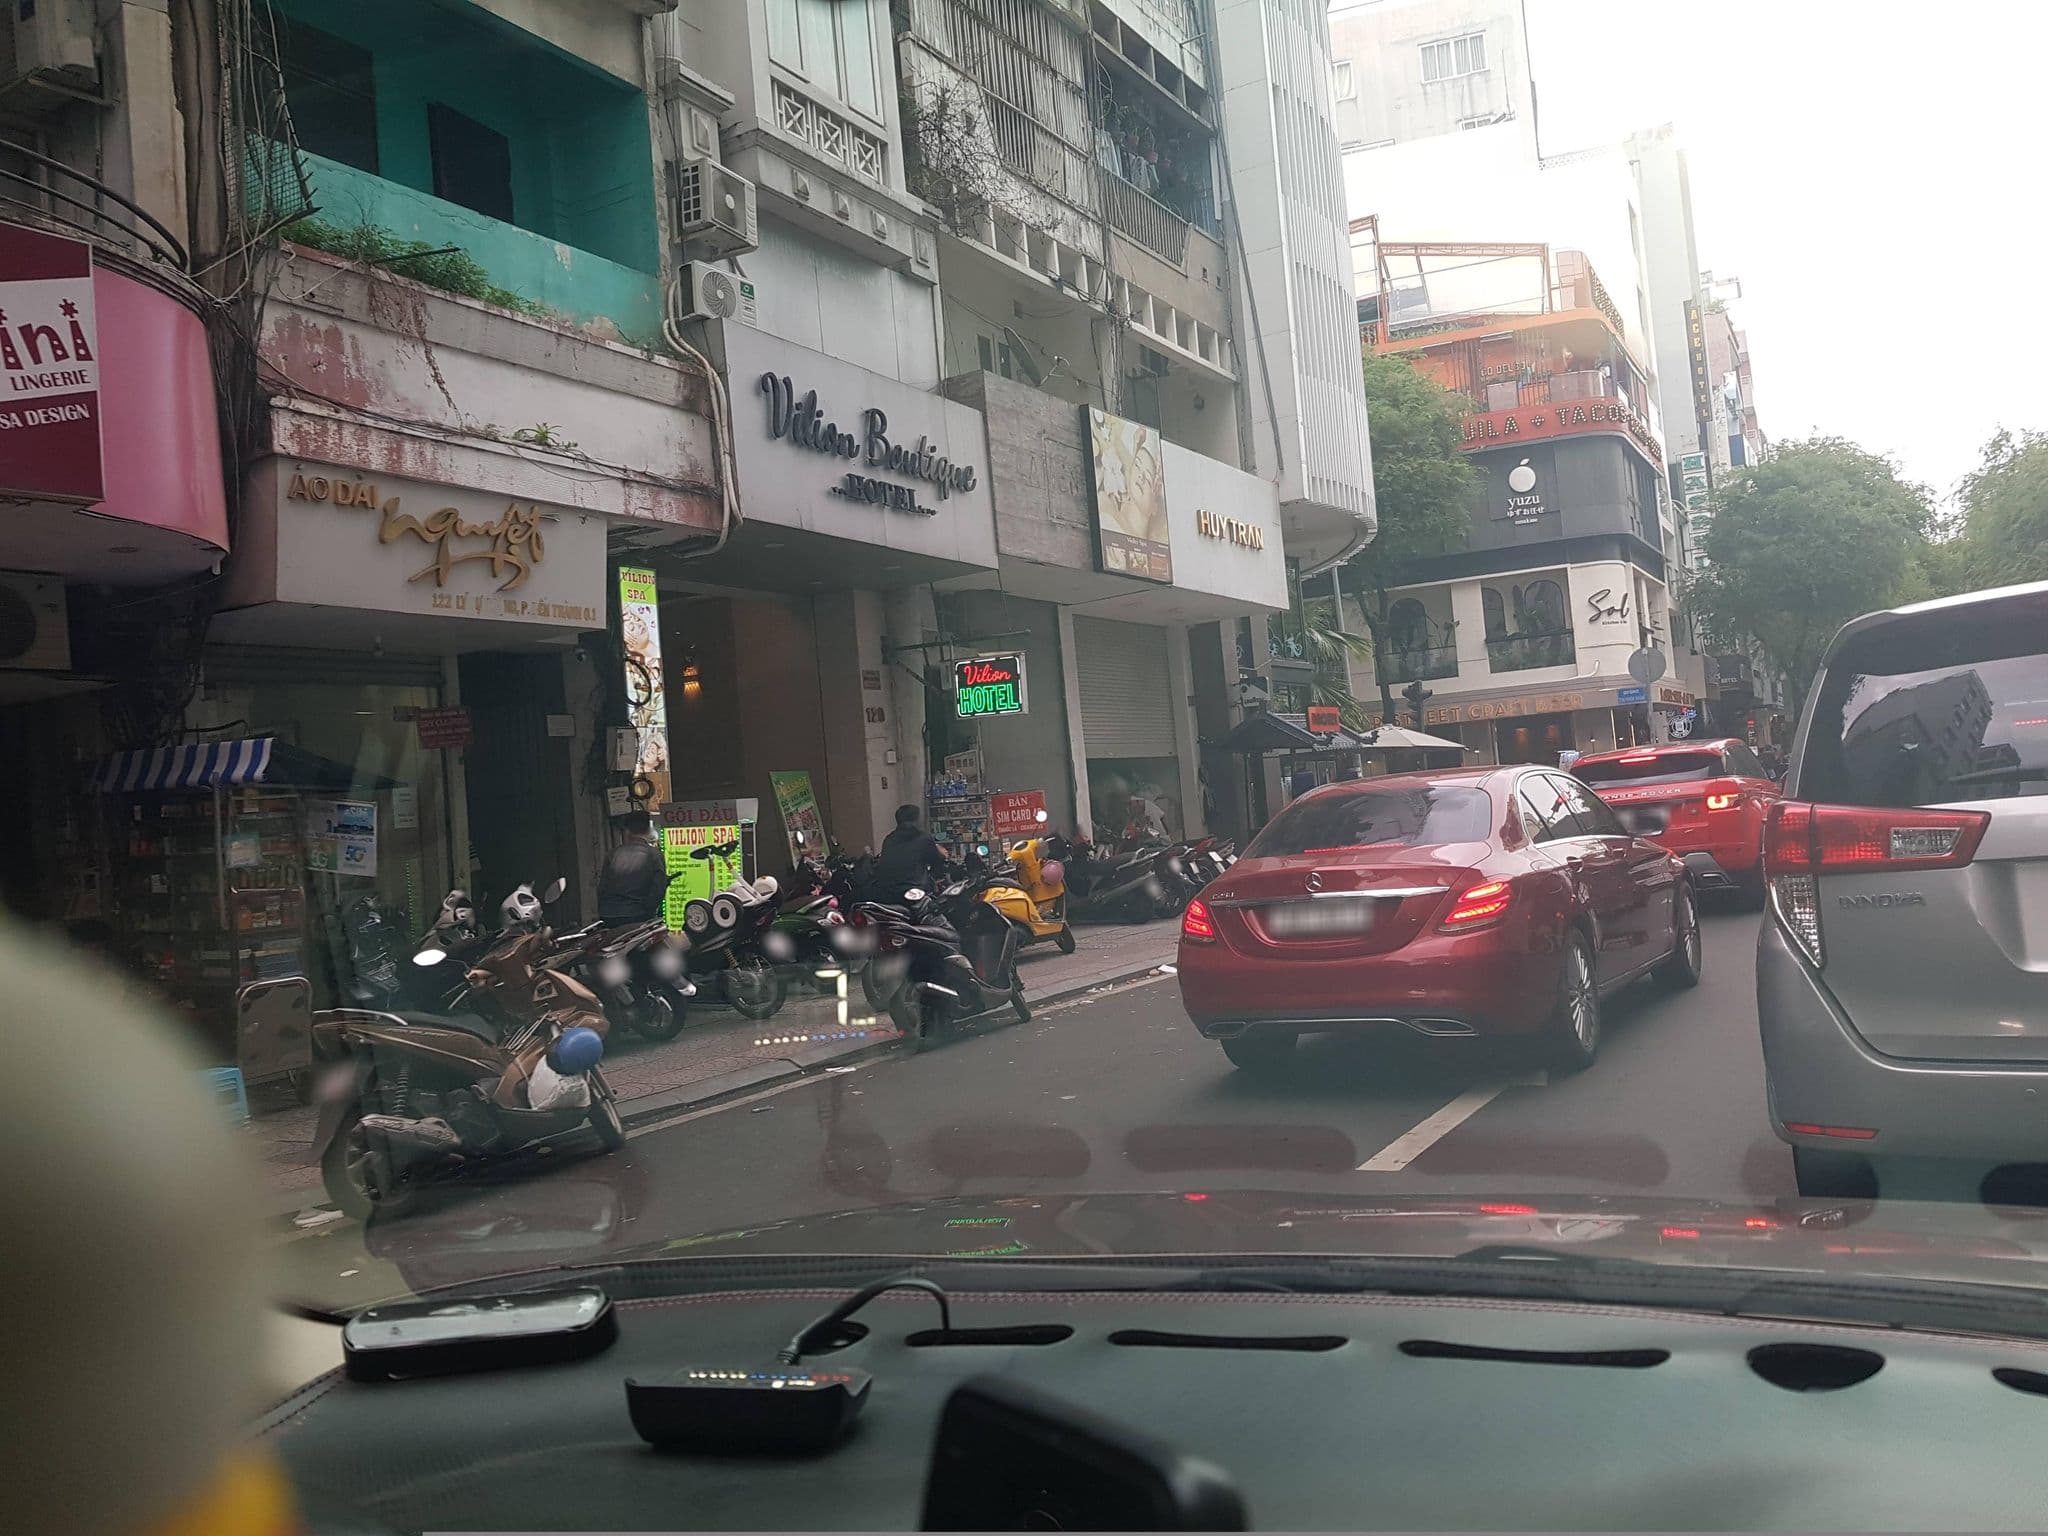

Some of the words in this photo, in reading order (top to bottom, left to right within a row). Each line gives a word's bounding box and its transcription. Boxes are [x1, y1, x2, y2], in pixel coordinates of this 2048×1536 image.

[10, 369, 91, 391] LINGERIE
[24, 404, 90, 427] DESIGN
[761, 371, 861, 459] Vilion
[863, 407, 978, 501] Boutique
[846, 473, 918, 513] HOTEL
[1508, 495, 1540, 510] yuzu
[1198, 509, 1230, 541] HUY
[621, 570, 656, 586] VILION
[626, 587, 647, 601] SPA
[1587, 588, 1630, 623] Sol
[963, 663, 1013, 686] Vilion
[959, 684, 1020, 714] HOTEL
[1393, 707, 1461, 727] STEET
[1008, 795, 1028, 807] BÁN
[996, 810, 1010, 824] SIM
[1011, 808, 1031, 822] CARD
[668, 828, 706, 846] VILION
[713, 827, 735, 844] SPA
[1838, 891, 1927, 909] INNOVA
